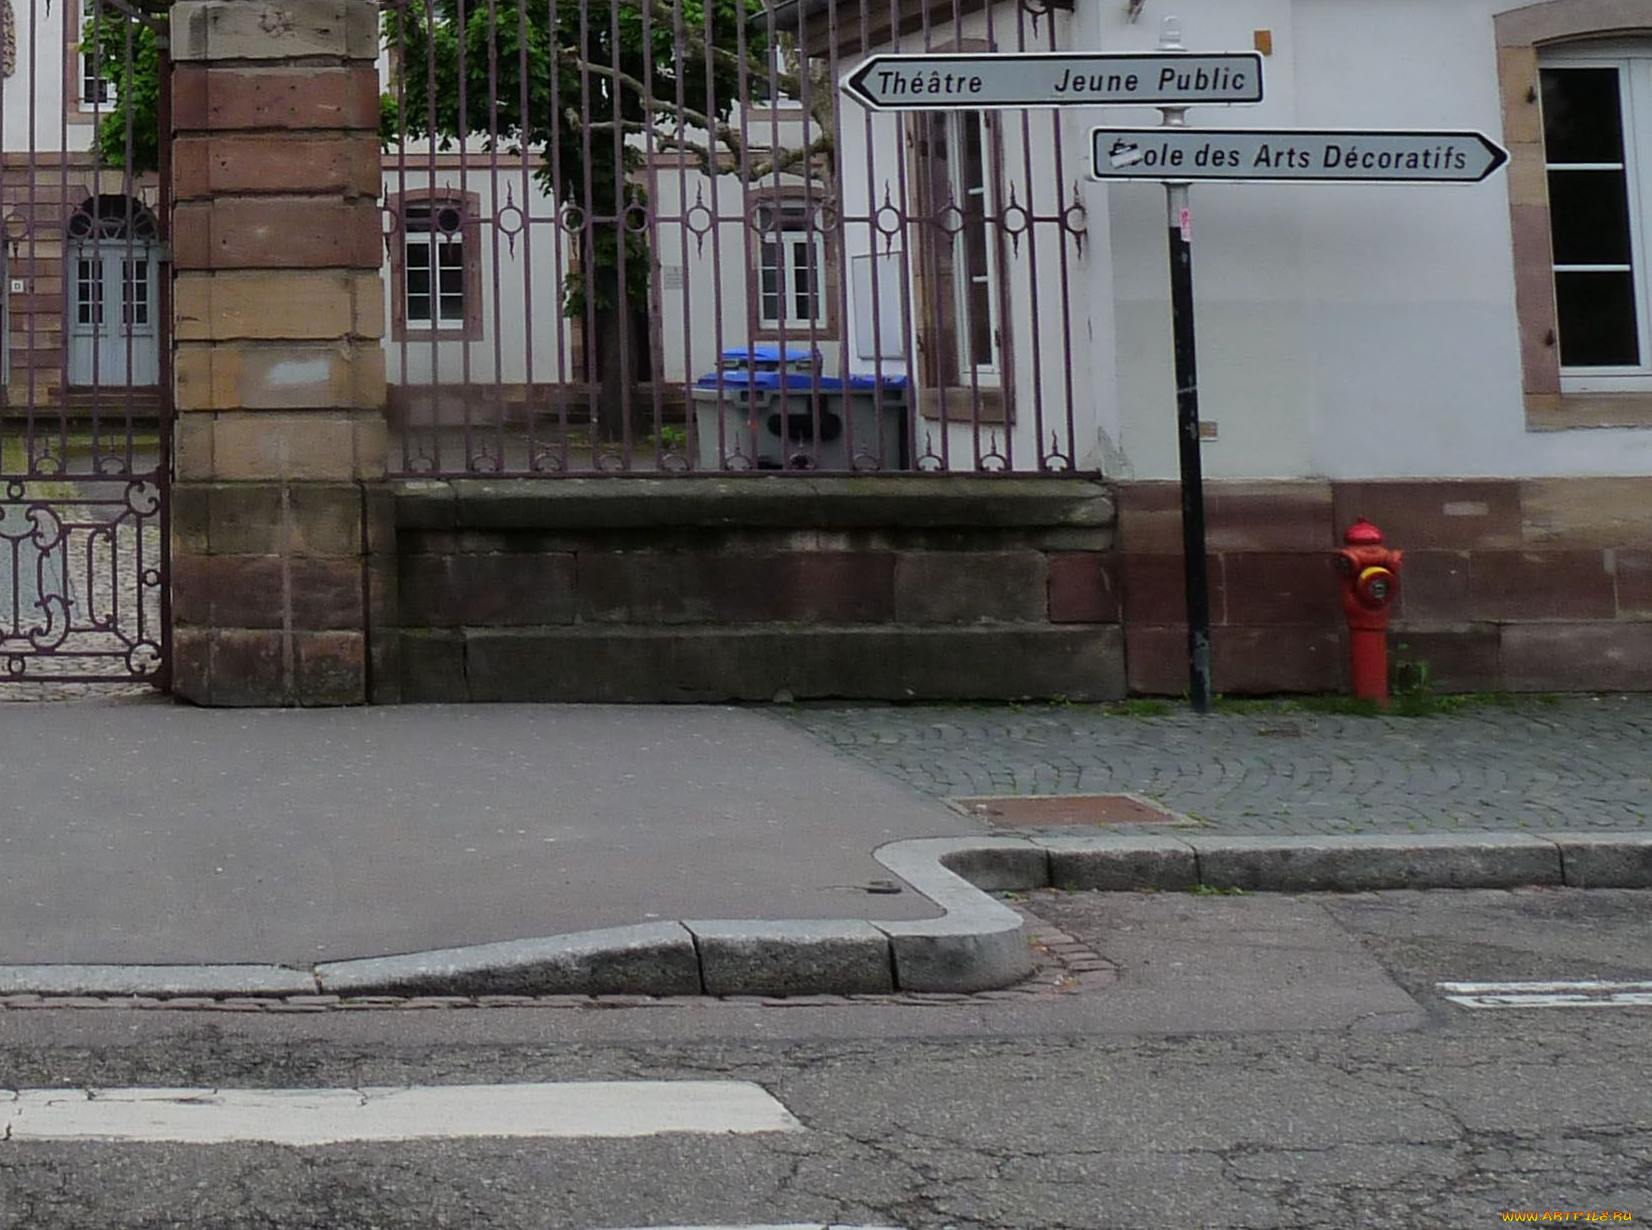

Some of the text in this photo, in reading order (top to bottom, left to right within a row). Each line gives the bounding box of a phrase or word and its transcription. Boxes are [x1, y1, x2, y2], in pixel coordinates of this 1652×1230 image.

[878, 67, 1245, 94] Théâtre Jeune Public
[1195, 143, 1240, 167] des
[1254, 144, 1310, 168] Arts
[1323, 145, 1466, 169] Décoratifs
